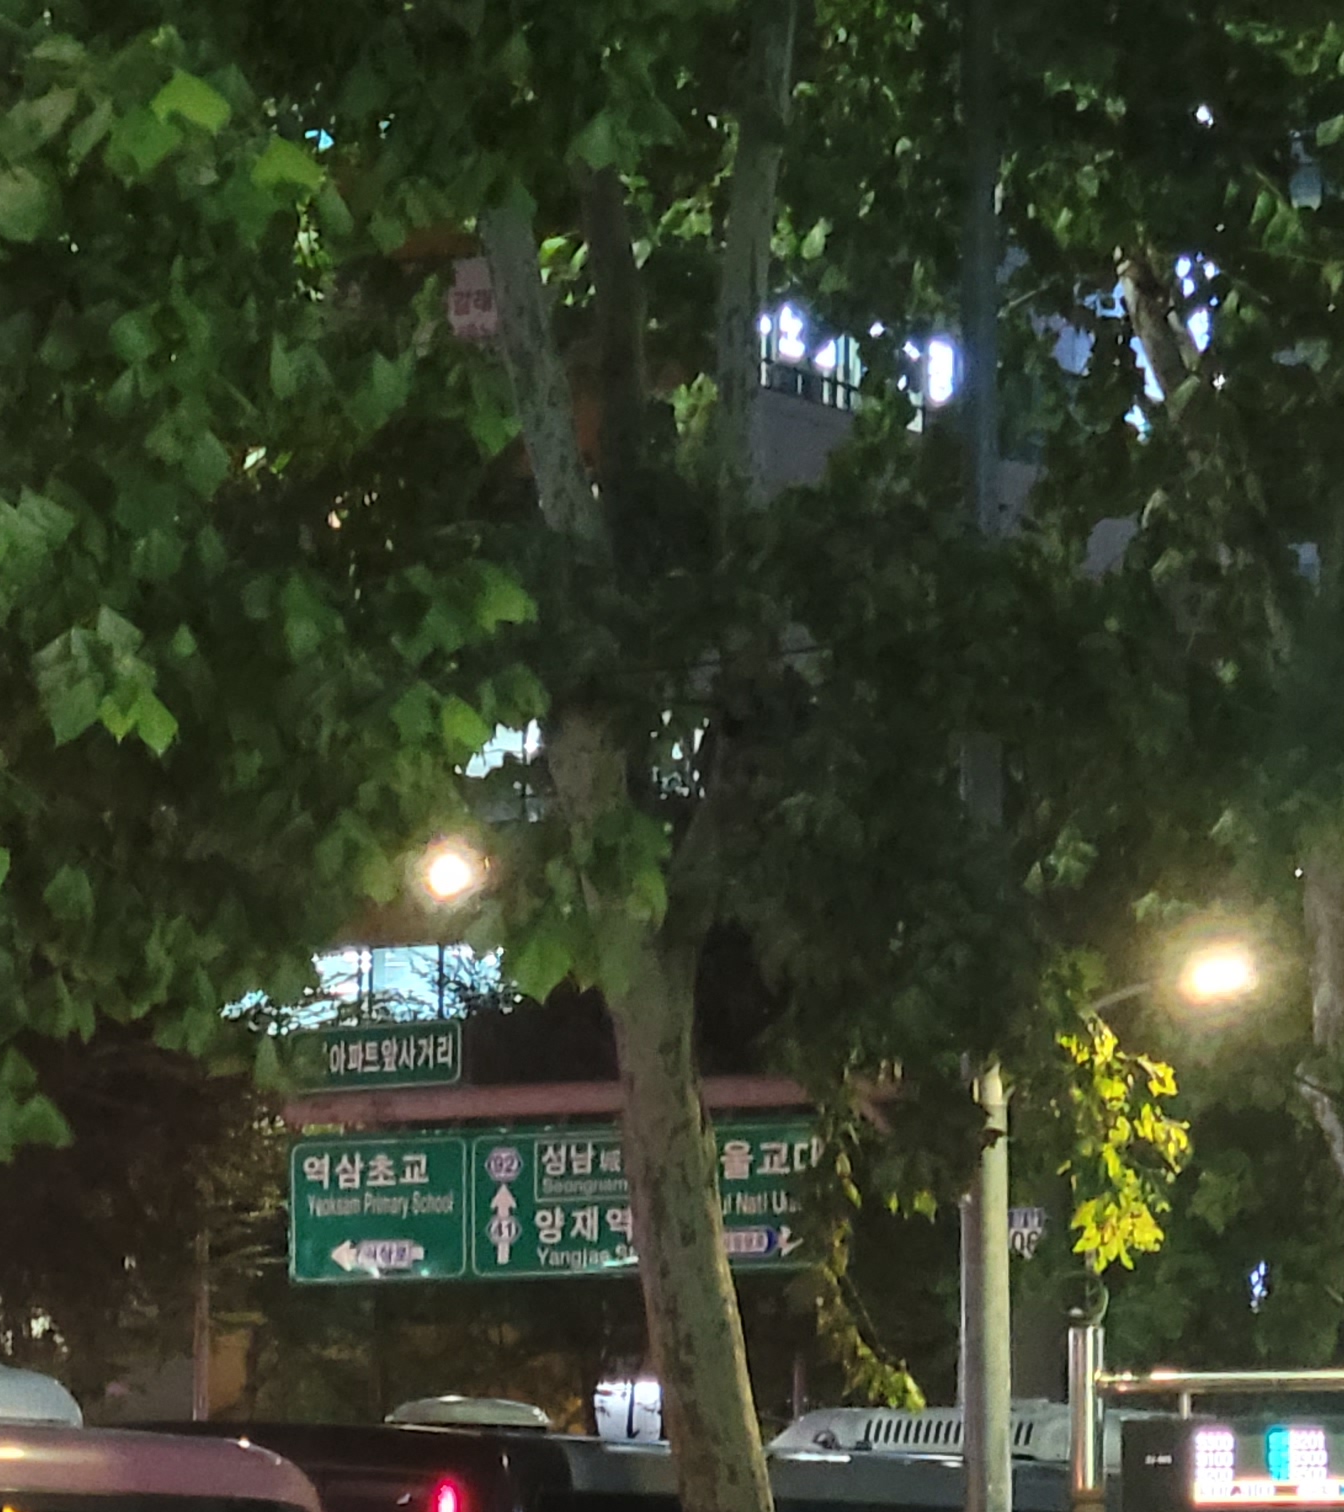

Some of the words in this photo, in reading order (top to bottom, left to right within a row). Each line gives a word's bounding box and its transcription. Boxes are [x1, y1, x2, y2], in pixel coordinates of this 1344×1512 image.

[324, 1031, 453, 1076] 아파트앞사거리
[303, 1152, 430, 1190] 역삼초교
[534, 1205, 633, 1244] 양재역
